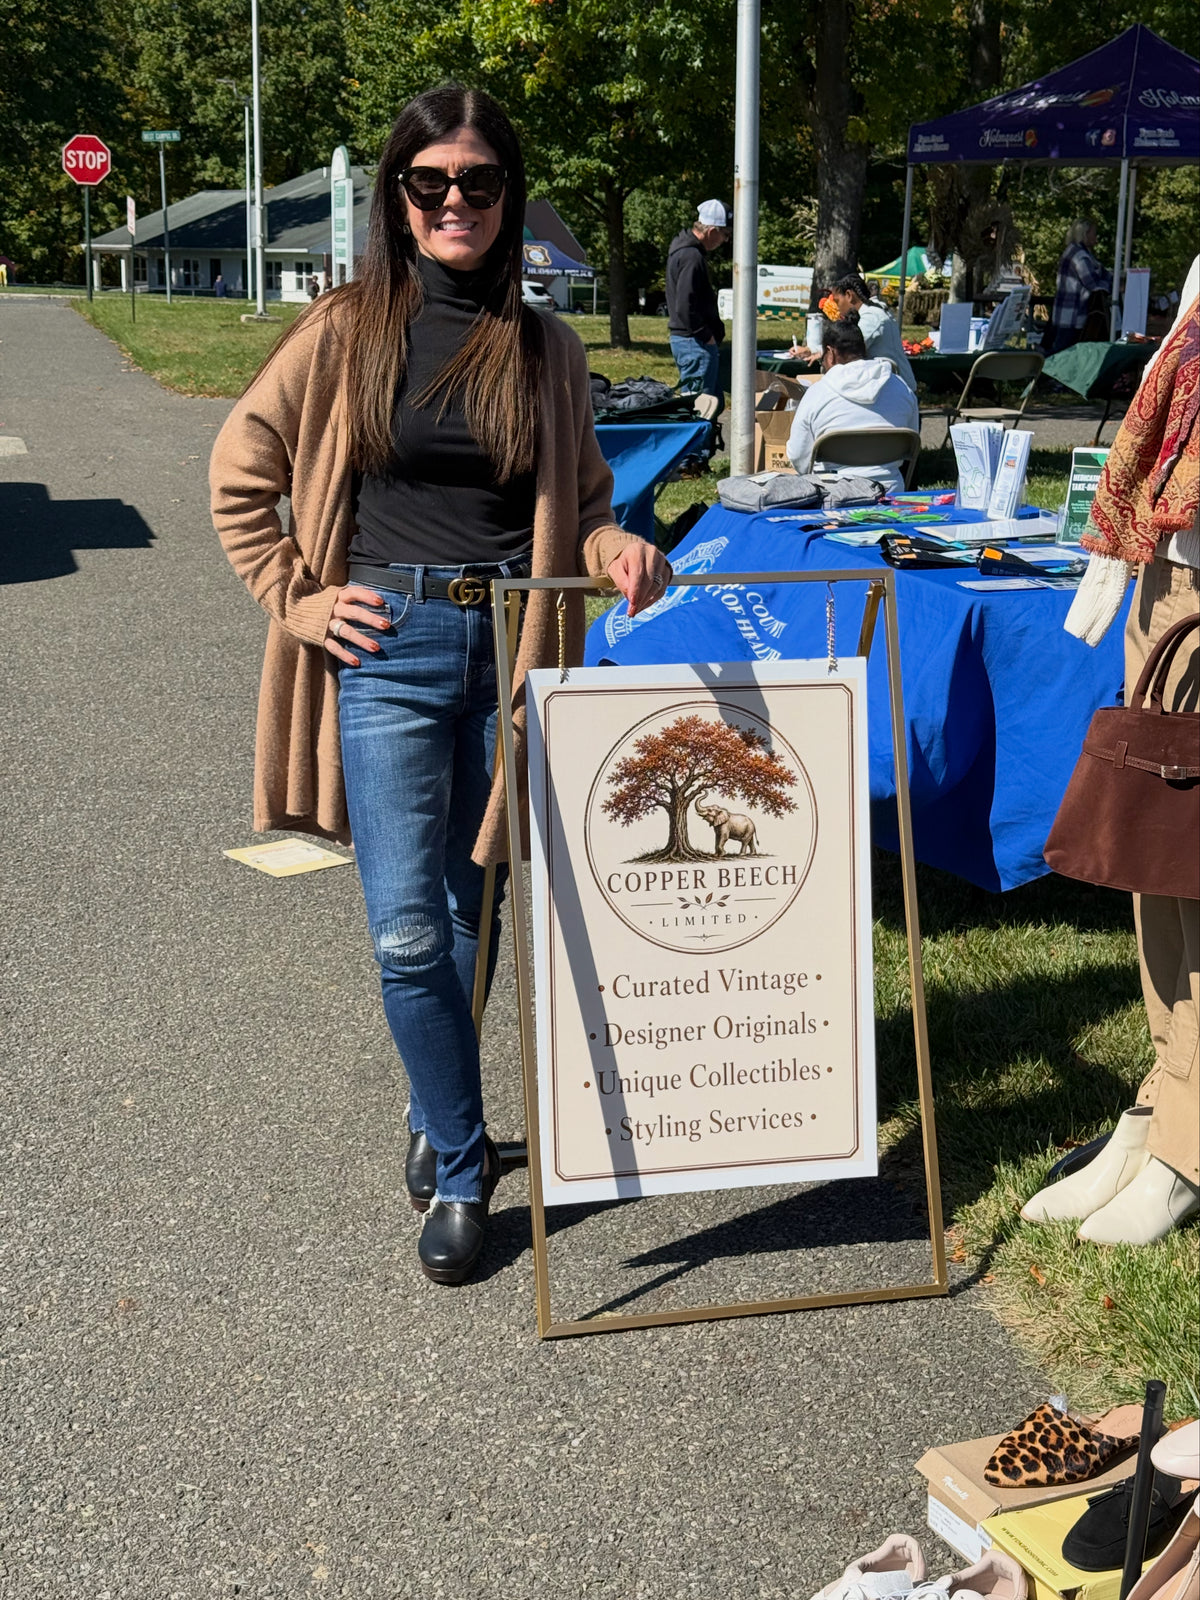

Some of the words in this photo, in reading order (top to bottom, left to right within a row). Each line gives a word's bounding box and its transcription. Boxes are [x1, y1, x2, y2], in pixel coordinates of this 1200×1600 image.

[66, 149, 107, 170] STOP
[528, 267, 562, 275] HUDSON
[564, 269, 594, 277] POLICE
[771, 460, 793, 469] PROM
[721, 593, 746, 616] OF
[607, 869, 707, 894] COPPER
[718, 865, 798, 889] BEECH
[661, 913, 747, 928] LIMITED
[612, 969, 710, 999] Curated
[718, 968, 809, 996] Vintage
[603, 1021, 706, 1050] Designer
[713, 1011, 817, 1044] Originals
[597, 1069, 682, 1098] Unique
[689, 1057, 821, 1089] Collectibles
[620, 1114, 702, 1146] Styling
[709, 1107, 803, 1135] Services
